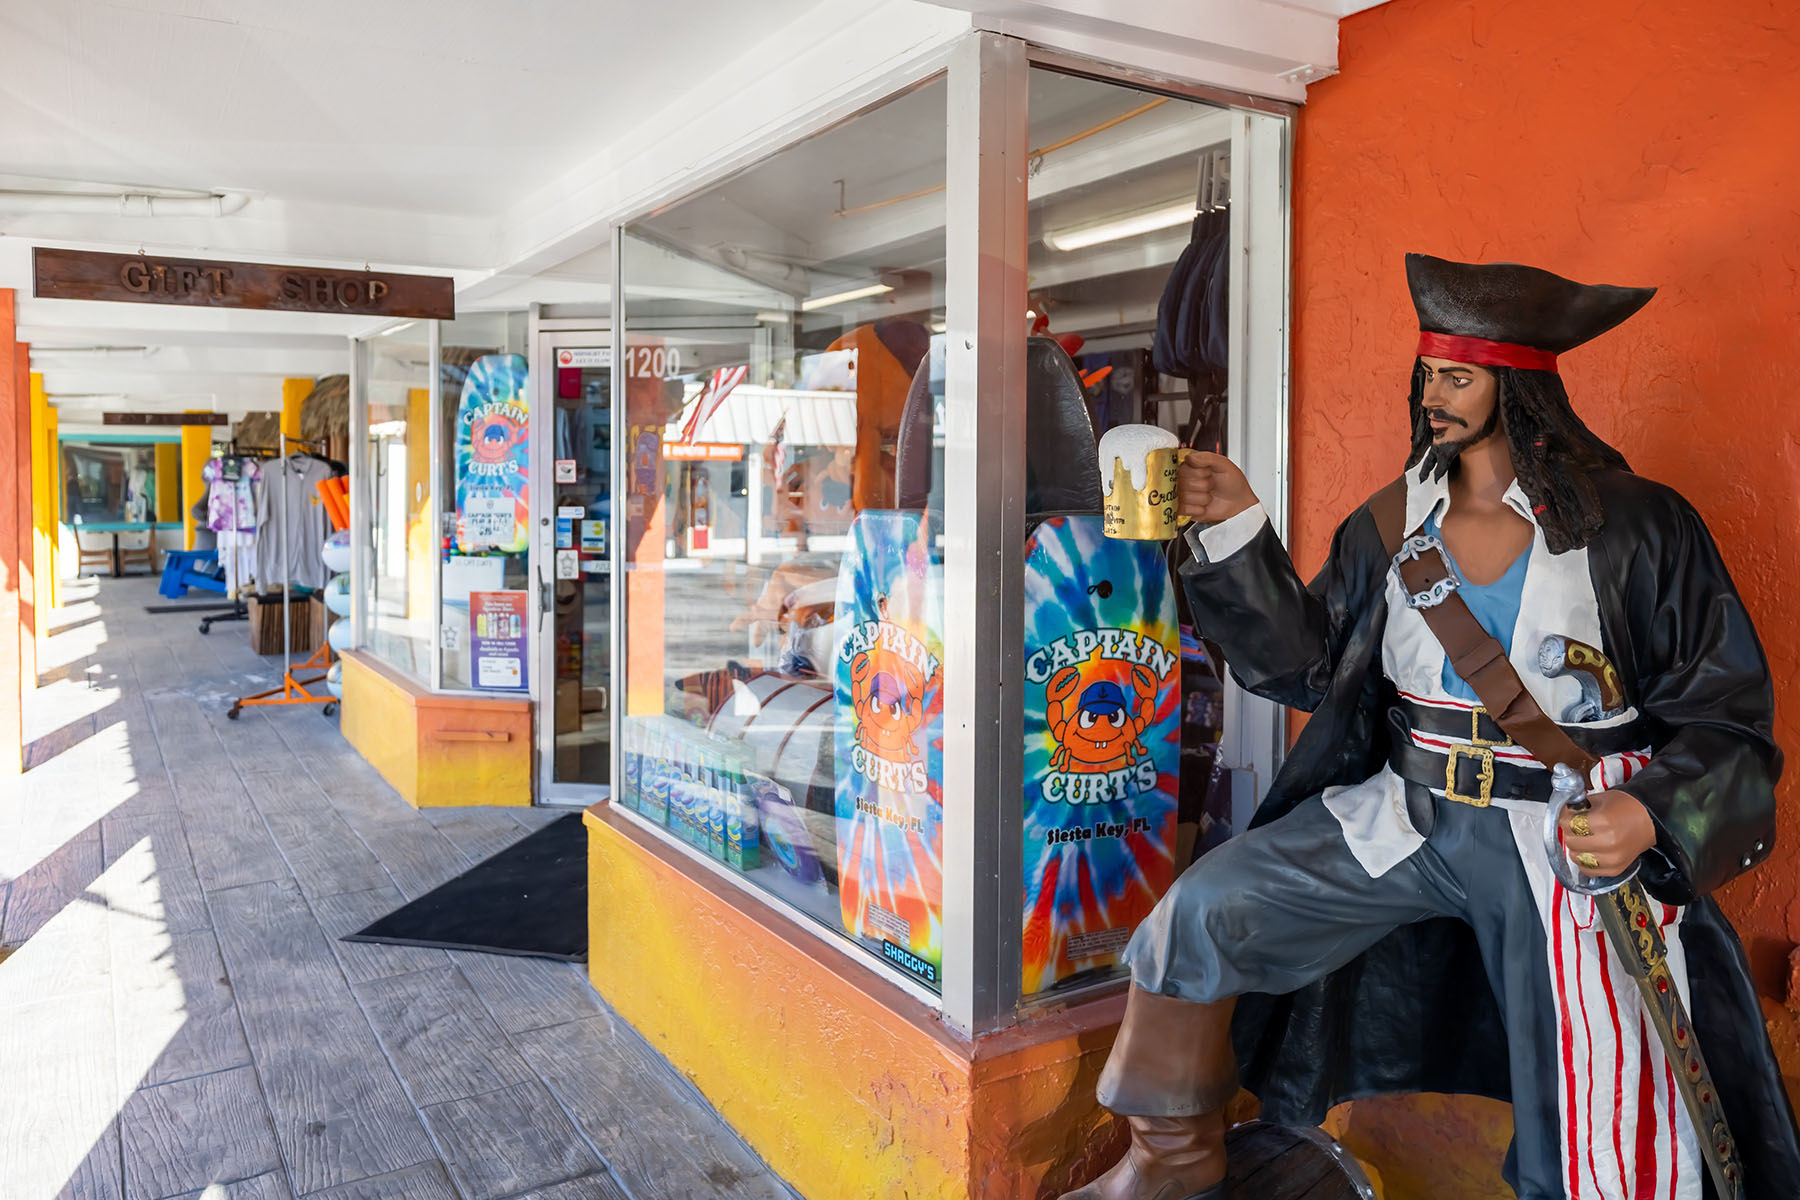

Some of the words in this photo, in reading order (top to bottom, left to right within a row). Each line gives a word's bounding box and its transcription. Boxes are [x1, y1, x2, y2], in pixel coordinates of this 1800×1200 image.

[120, 262, 233, 298] GIFT
[279, 274, 389, 305] SHOP
[625, 347, 680, 378] 1200
[463, 402, 529, 425] CAPTAIN
[468, 459, 519, 476] CURT'S
[840, 620, 939, 683] CAPTAIN
[1025, 628, 1178, 683] CAPTAIN
[852, 744, 928, 793] CURT'S
[1041, 758, 1158, 805] CURT'S
[856, 797, 882, 818] Siesta
[885, 807, 909, 831] Key,
[911, 816, 924, 833] FL
[1047, 826, 1091, 845] Siesta
[1095, 822, 1129, 842] Key,
[1133, 817, 1151, 832] FL
[884, 942, 935, 981] SHAGGY'S
